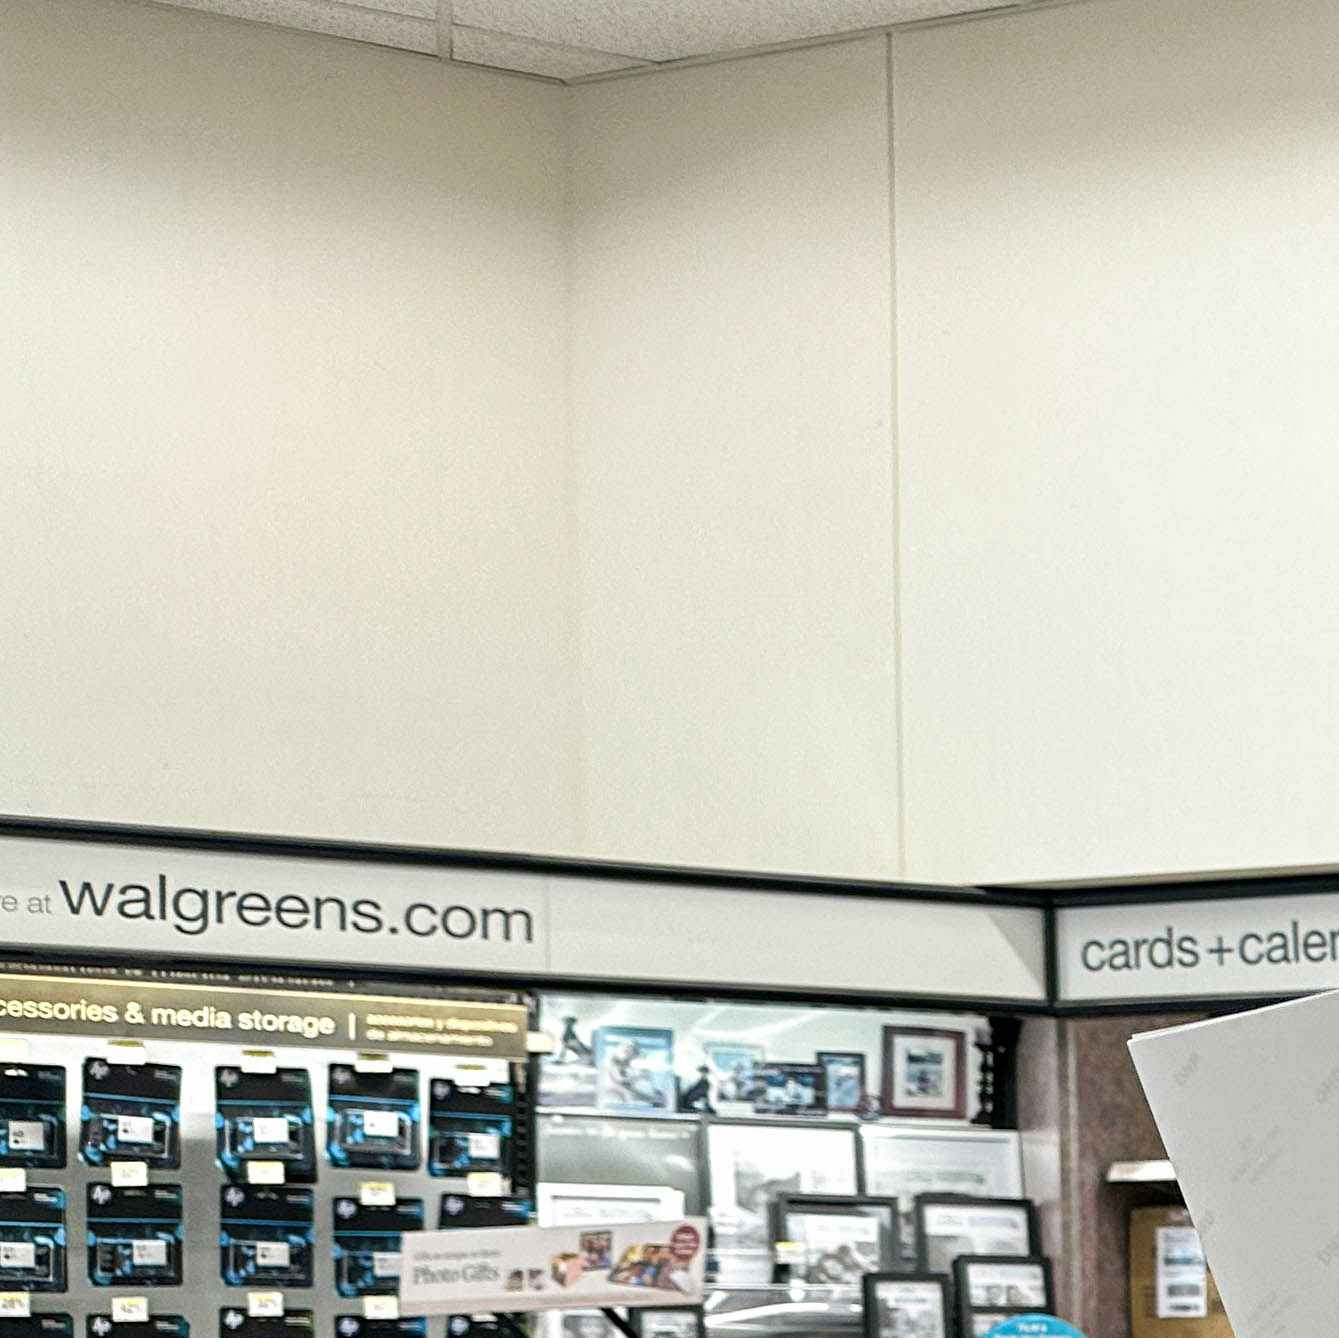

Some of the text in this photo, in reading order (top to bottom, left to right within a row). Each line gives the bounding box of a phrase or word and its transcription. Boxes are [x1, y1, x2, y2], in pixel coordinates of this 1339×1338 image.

[28, 895, 52, 913] at
[59, 874, 533, 943] walgreens.com
[124, 1001, 145, 1024] &
[152, 1005, 232, 1028] media
[239, 1012, 336, 1039] storage
